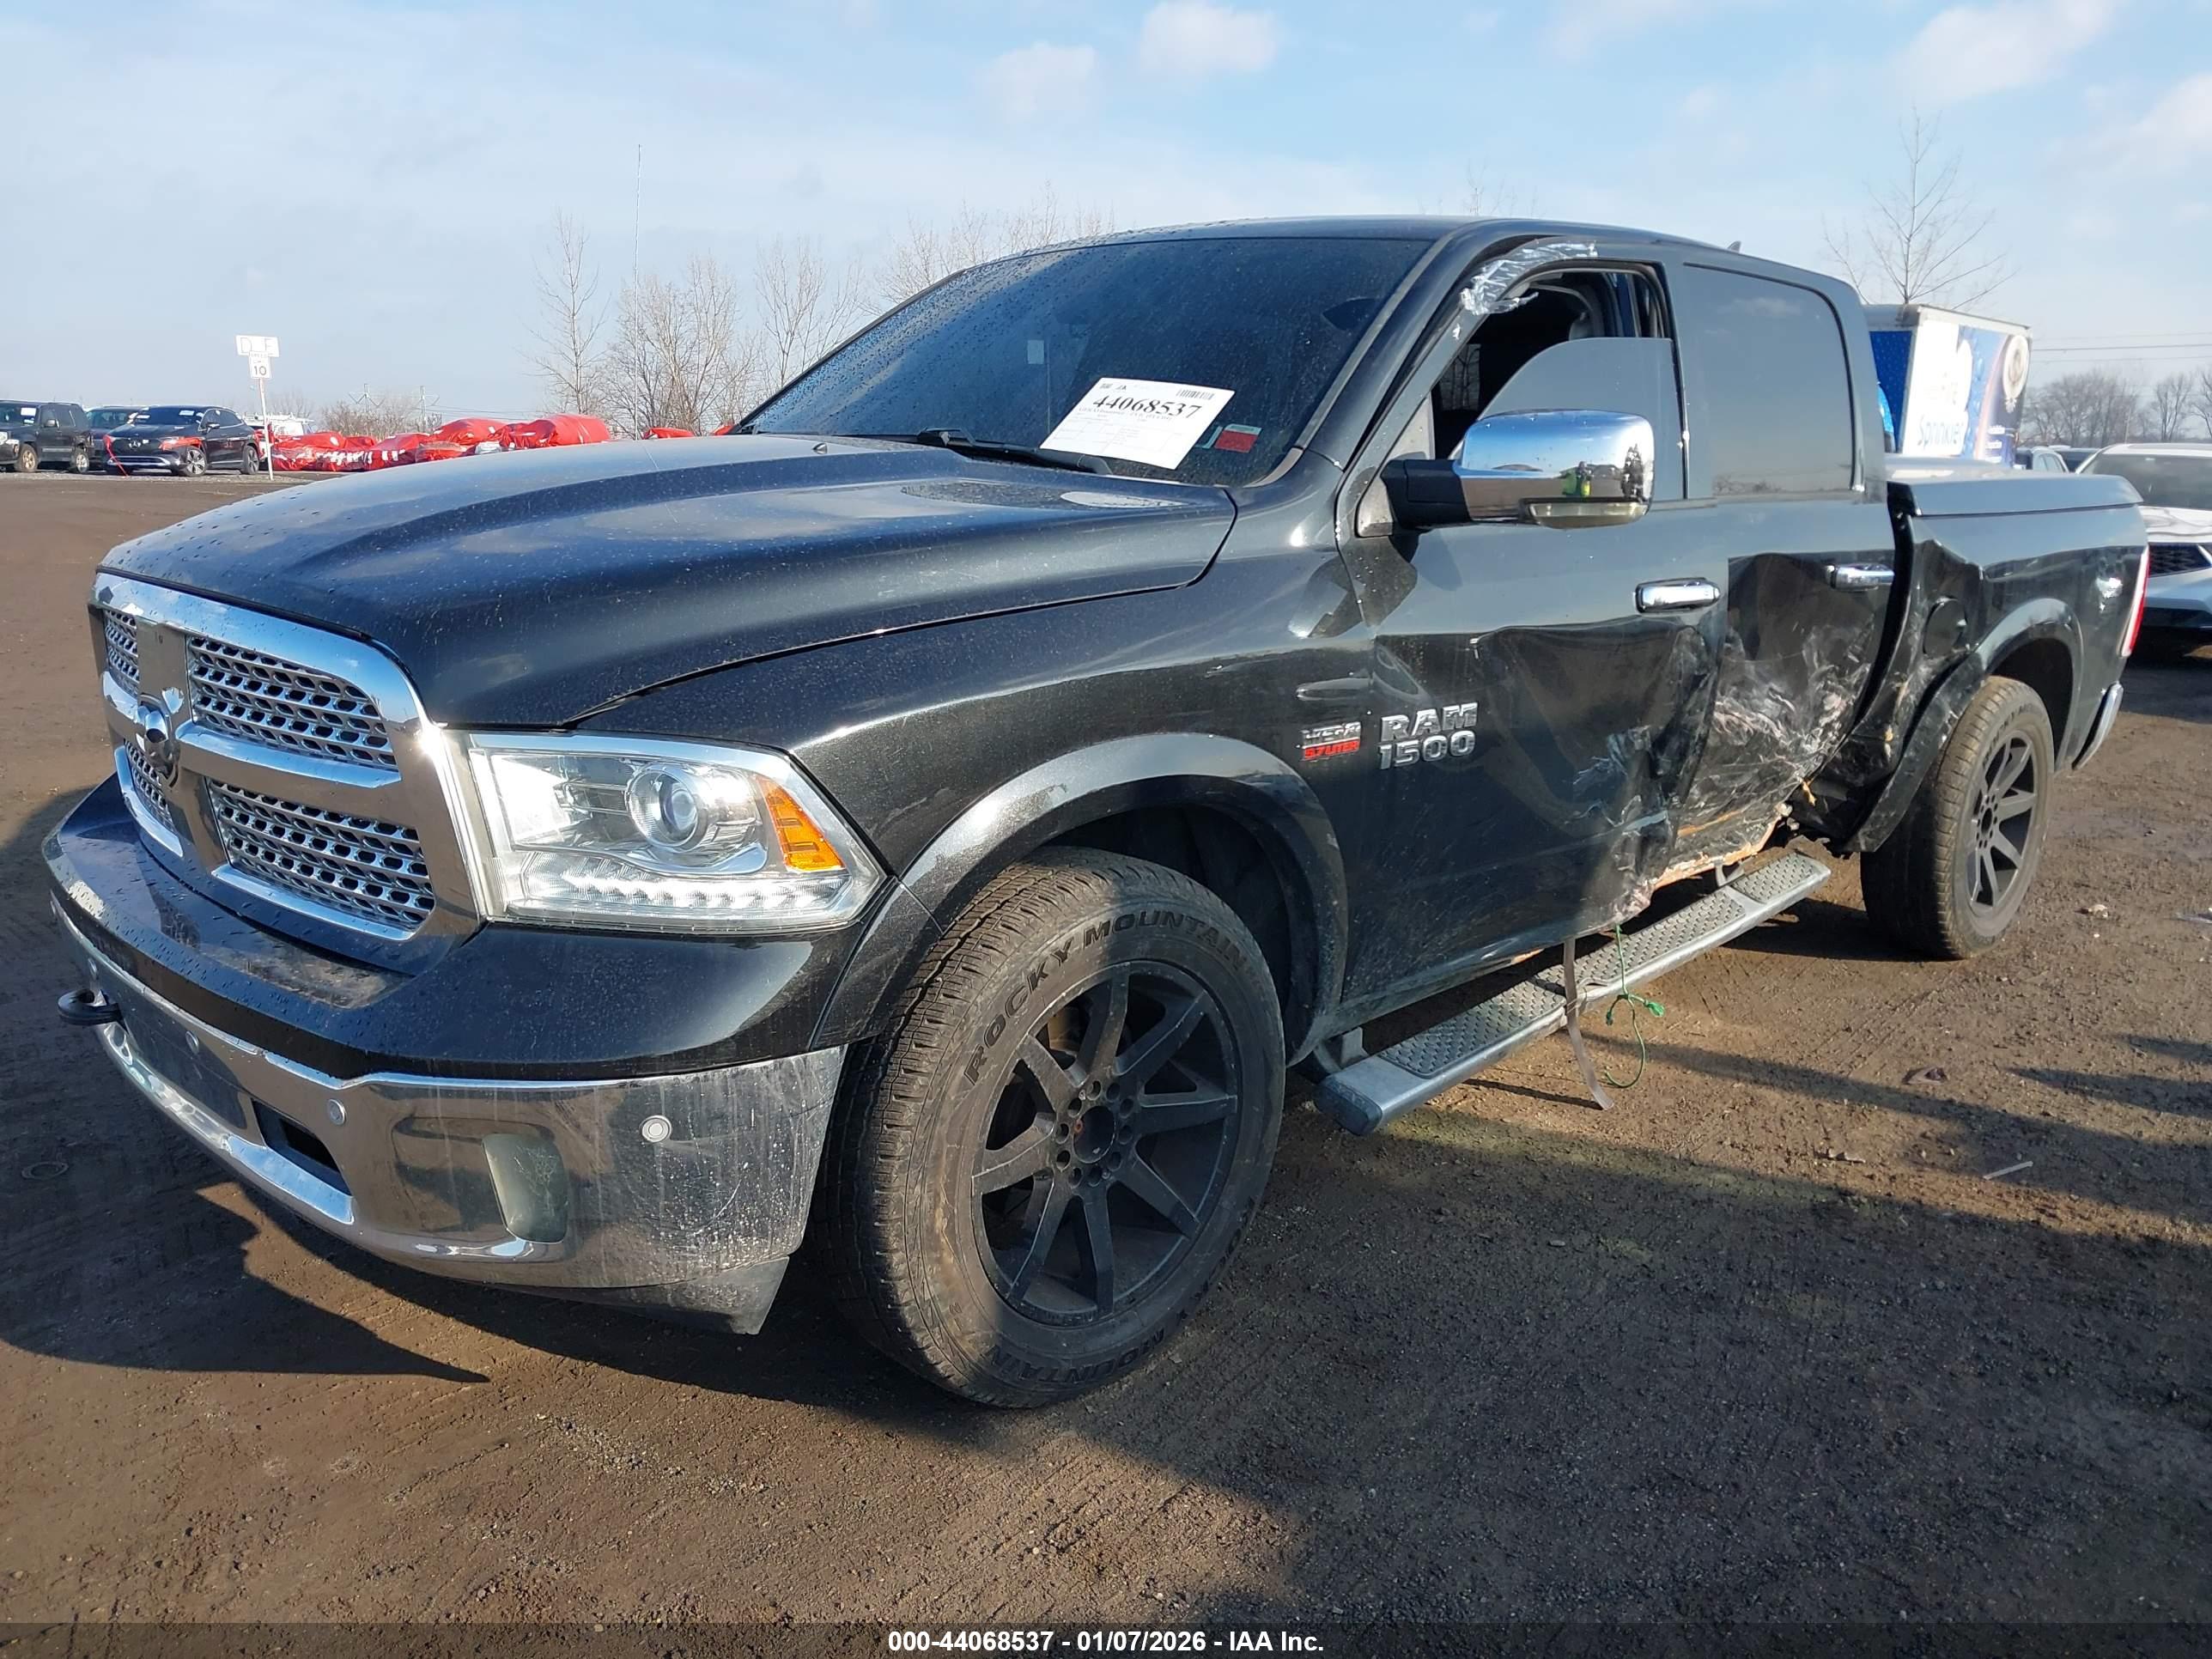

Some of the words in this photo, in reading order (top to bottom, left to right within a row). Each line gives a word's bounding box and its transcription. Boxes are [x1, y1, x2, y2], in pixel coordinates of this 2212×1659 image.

[254, 366, 267, 376] 10
[1093, 395, 1202, 418] 44068537
[1380, 702, 1479, 742] RAM
[1377, 730, 1477, 770] 1500
[963, 939, 1074, 1085] ROCKY
[1082, 908, 1248, 972] MOUNTAIN
